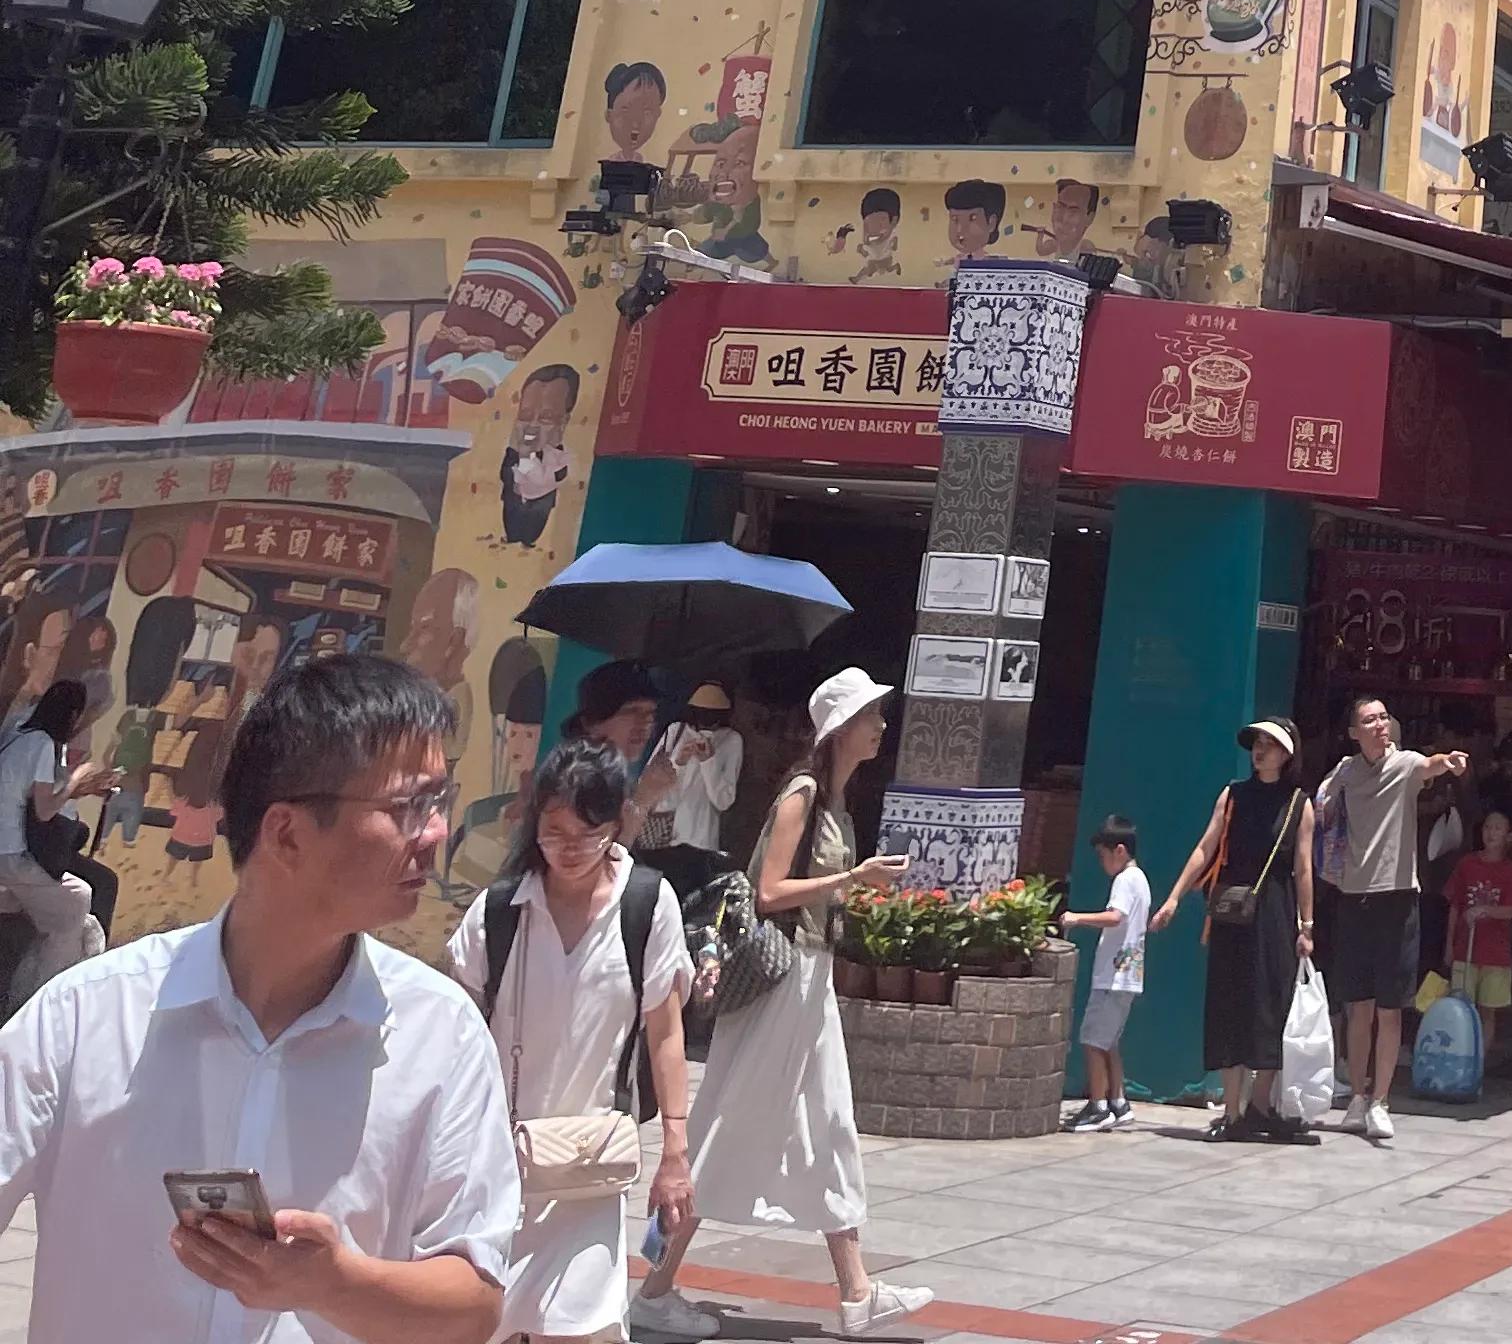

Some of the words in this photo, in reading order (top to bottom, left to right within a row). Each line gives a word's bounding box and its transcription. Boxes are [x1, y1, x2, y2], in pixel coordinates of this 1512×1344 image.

[739, 413, 771, 428] CHOI
[773, 414, 818, 431] HEONG
[820, 416, 855, 432] YUEN
[858, 418, 912, 435] BAKERY
[1295, 420, 1339, 445] 澳門
[1292, 447, 1335, 472] 製造
[223, 524, 380, 568] 咀香園餅家
